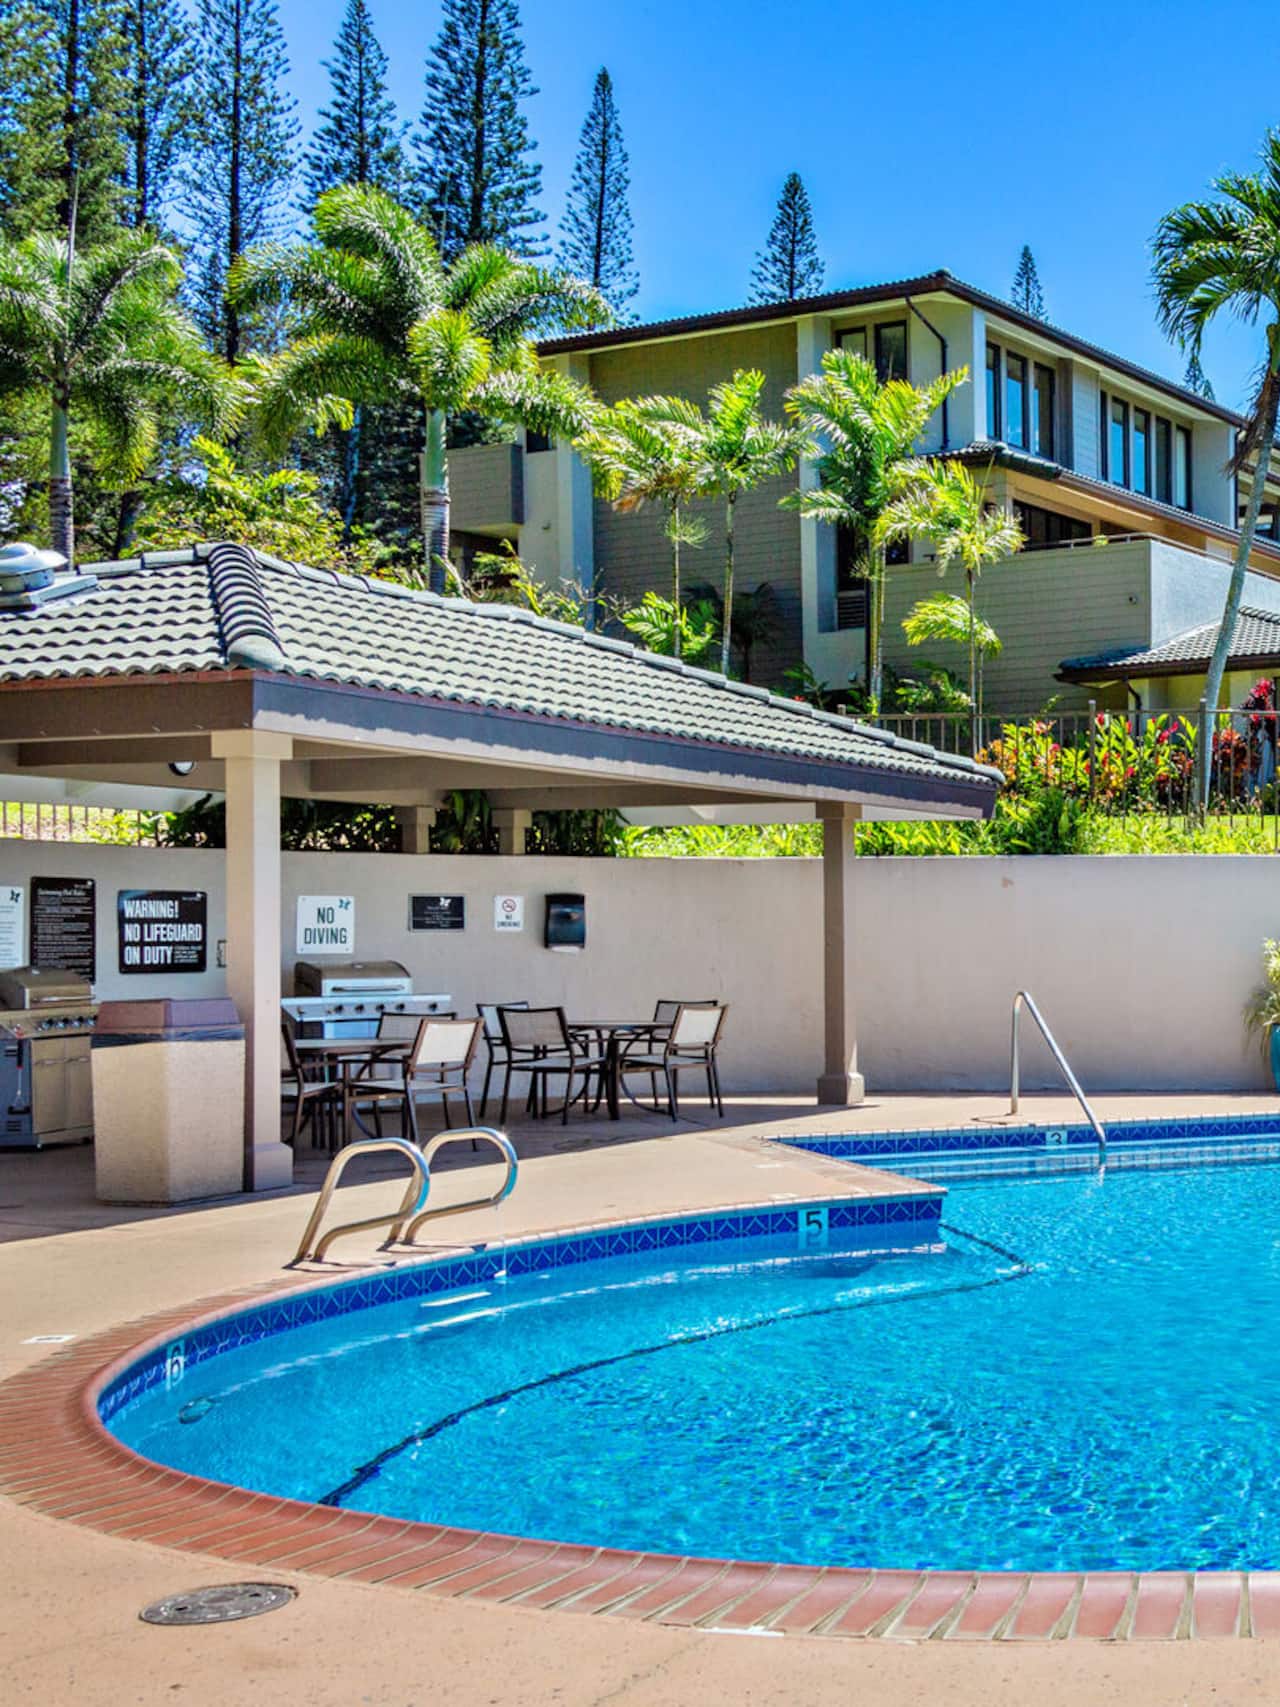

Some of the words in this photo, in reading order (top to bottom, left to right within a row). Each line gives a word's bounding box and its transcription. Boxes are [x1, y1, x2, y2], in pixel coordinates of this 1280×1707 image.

[124, 900, 179, 919] WARNING!
[317, 906, 335, 924] NO
[124, 923, 141, 942] NO
[143, 923, 203, 942] LIFEGUARD
[304, 927, 347, 944] DIVING
[124, 945, 141, 965] ON
[143, 945, 174, 965] DUTY
[806, 1210, 822, 1230] 5
